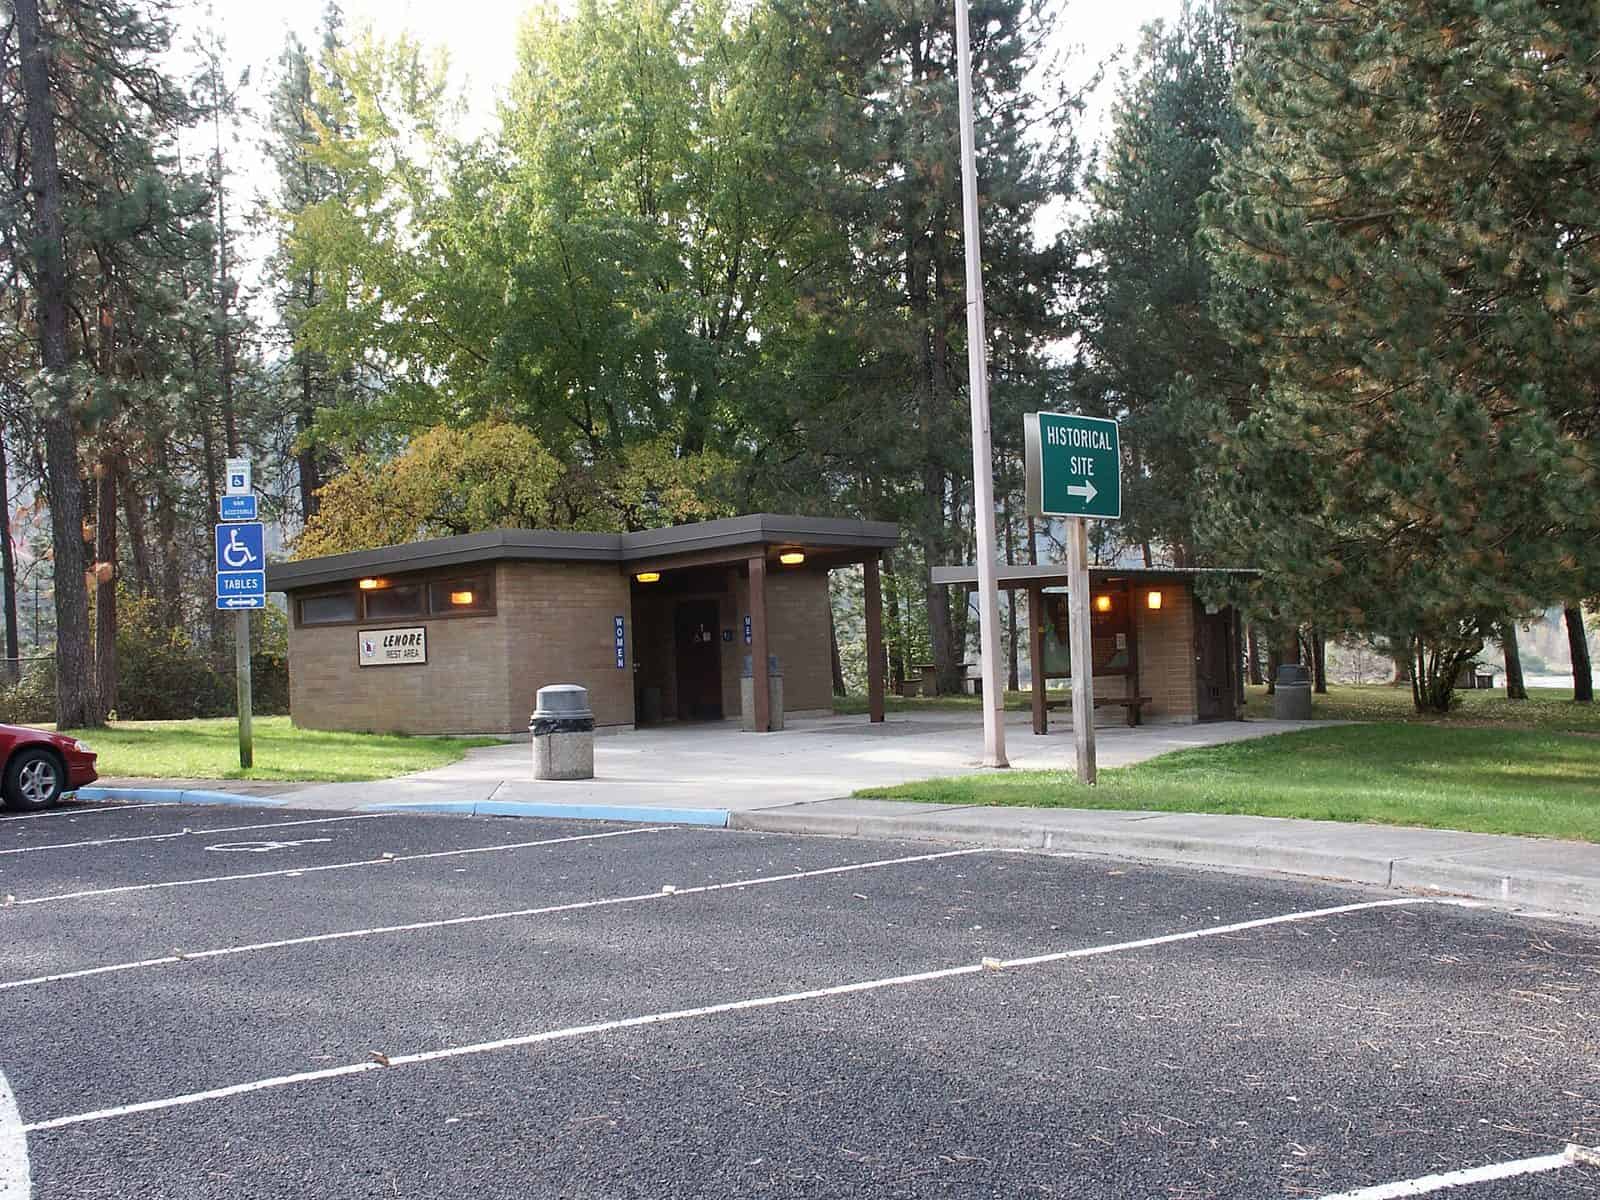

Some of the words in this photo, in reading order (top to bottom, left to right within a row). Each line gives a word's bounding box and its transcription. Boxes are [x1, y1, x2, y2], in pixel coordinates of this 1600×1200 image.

[1047, 425, 1113, 450] HISTORICAL
[1070, 456, 1095, 476] SITE
[224, 578, 258, 590] TABLES
[383, 633, 423, 648] LENORE
[615, 617, 624, 668] WOMEN
